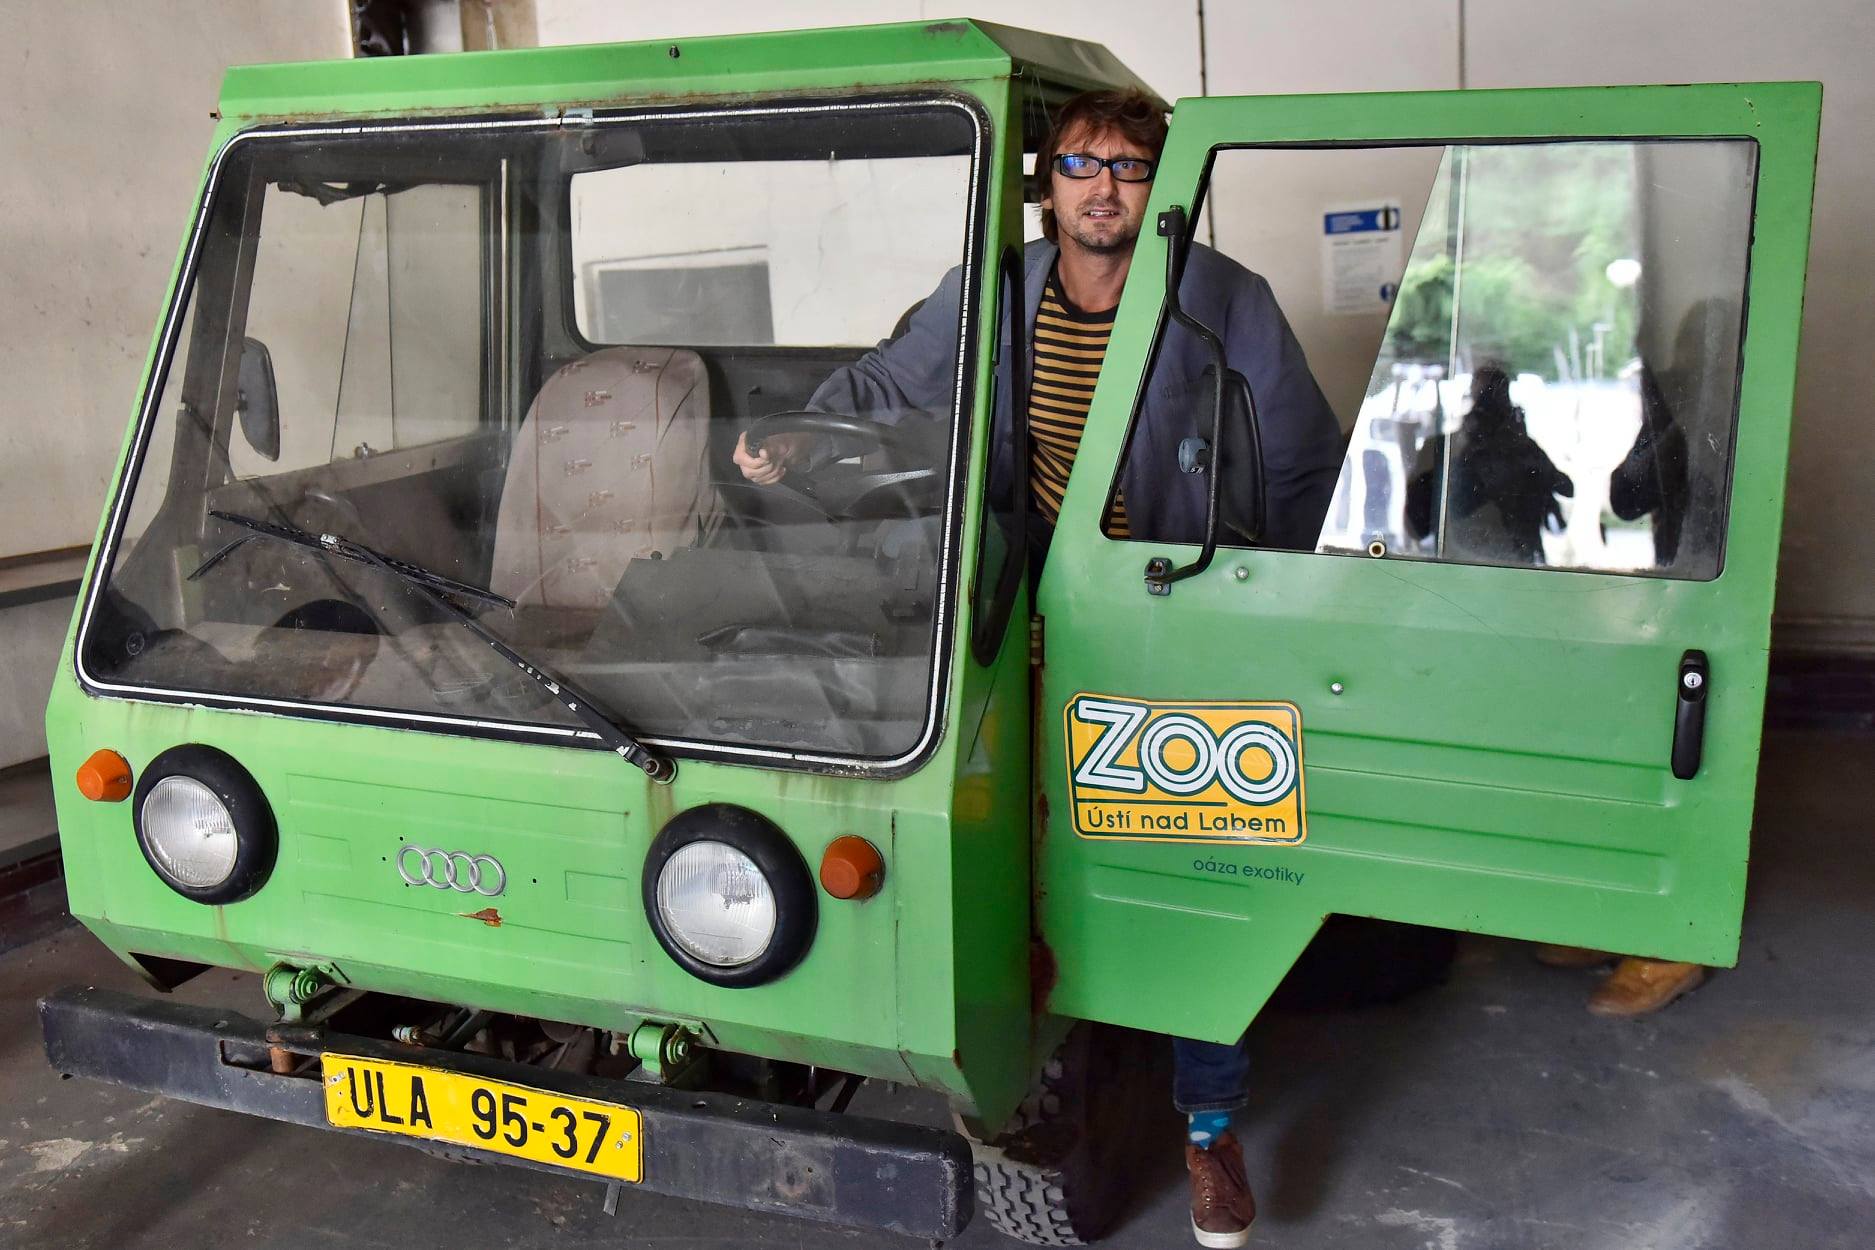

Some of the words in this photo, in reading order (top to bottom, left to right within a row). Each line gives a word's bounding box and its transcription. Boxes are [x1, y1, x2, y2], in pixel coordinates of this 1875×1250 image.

[1076, 698, 1297, 806] ZOO
[1087, 805, 1132, 829] Ústí
[1141, 811, 1189, 831] nad
[1199, 812, 1286, 833] Labem
[1193, 856, 1237, 875] oáza
[1242, 865, 1305, 886] exotiky
[347, 1067, 433, 1129] ULA
[471, 1088, 612, 1164] 95-37
